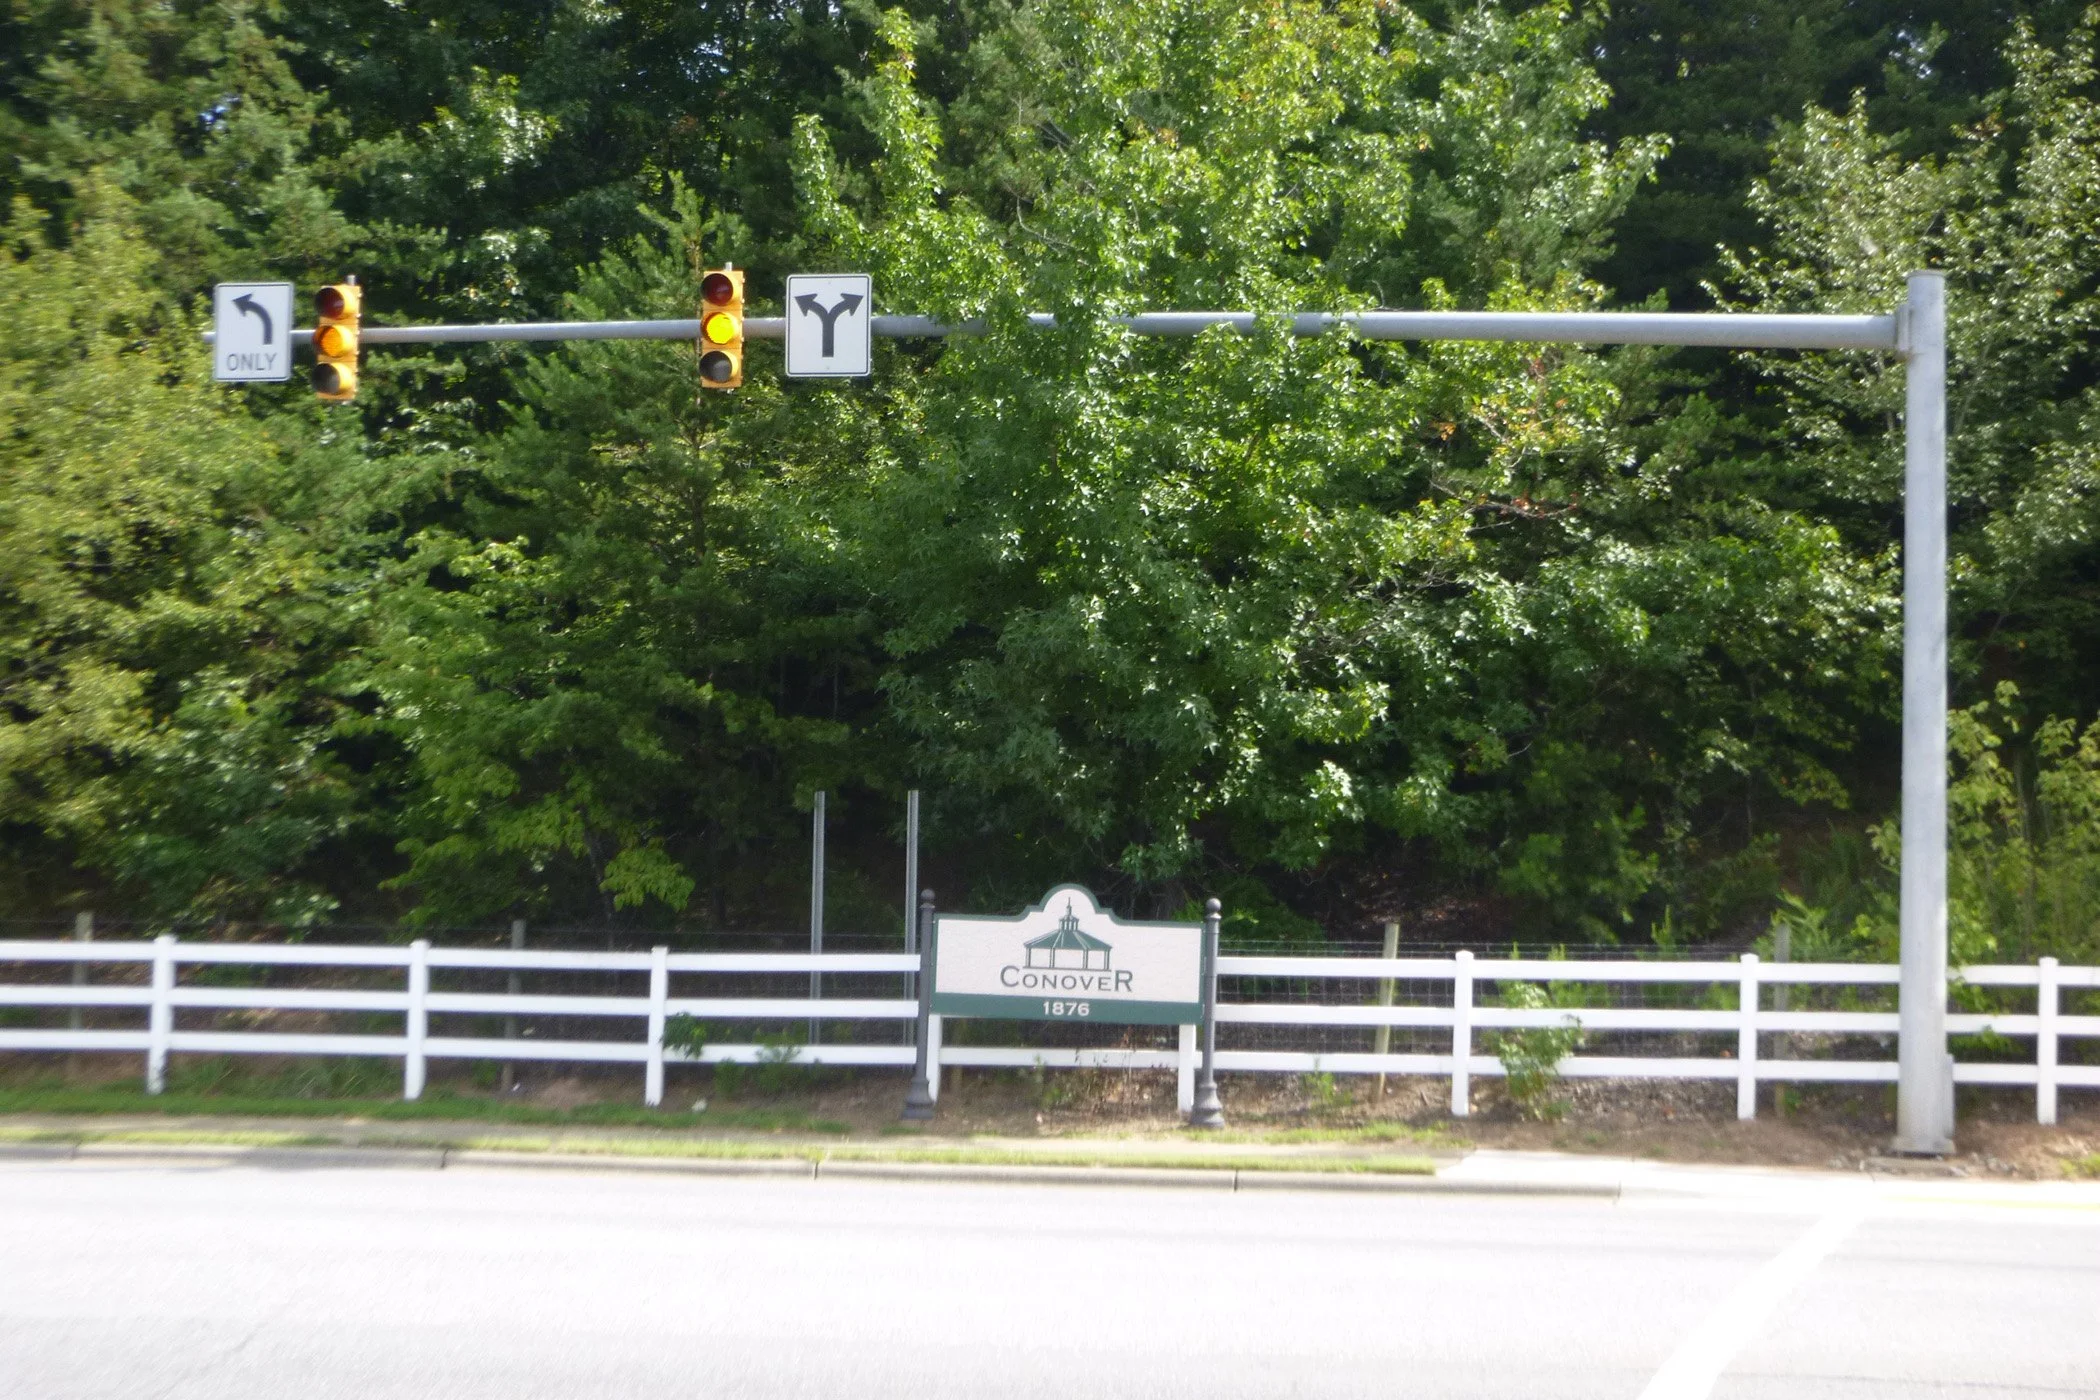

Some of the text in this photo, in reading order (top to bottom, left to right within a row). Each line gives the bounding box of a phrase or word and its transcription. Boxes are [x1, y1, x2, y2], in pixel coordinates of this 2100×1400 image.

[226, 352, 277, 371] ONLY
[1000, 965, 1133, 992] CONOVER
[1043, 1001, 1090, 1016] 1876
